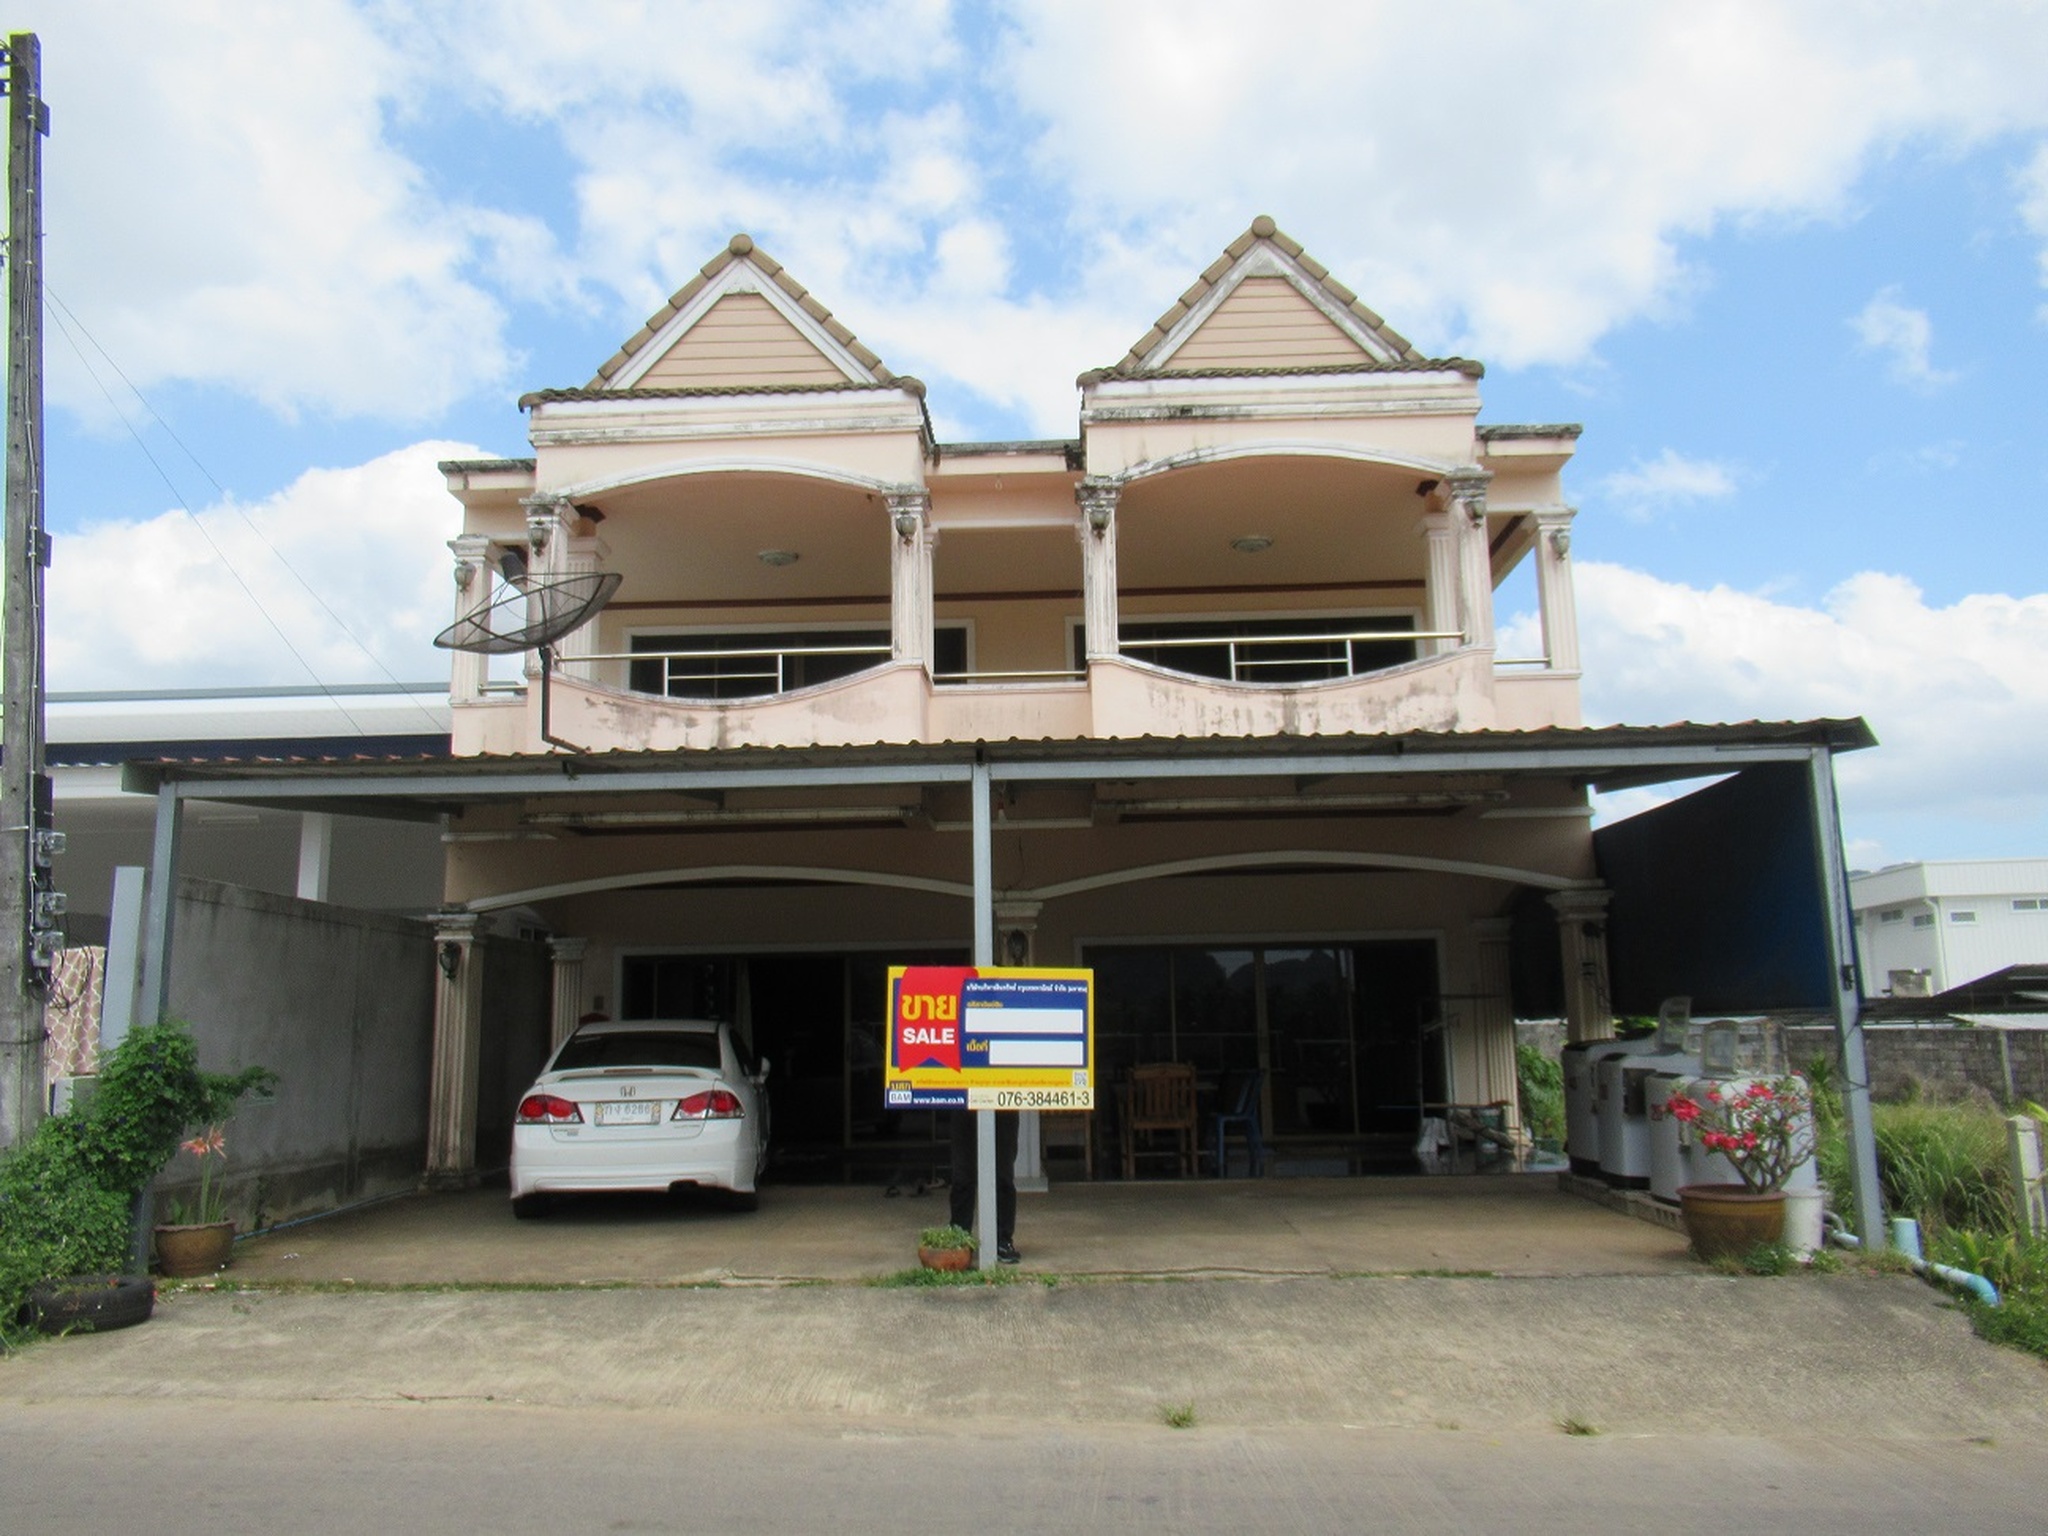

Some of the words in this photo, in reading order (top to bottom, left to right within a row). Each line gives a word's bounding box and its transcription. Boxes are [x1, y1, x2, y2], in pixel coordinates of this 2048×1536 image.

[902, 995, 957, 1021] ขาย
[903, 1028, 955, 1045] SALE
[997, 1091, 1090, 1107] 076-384461-3
